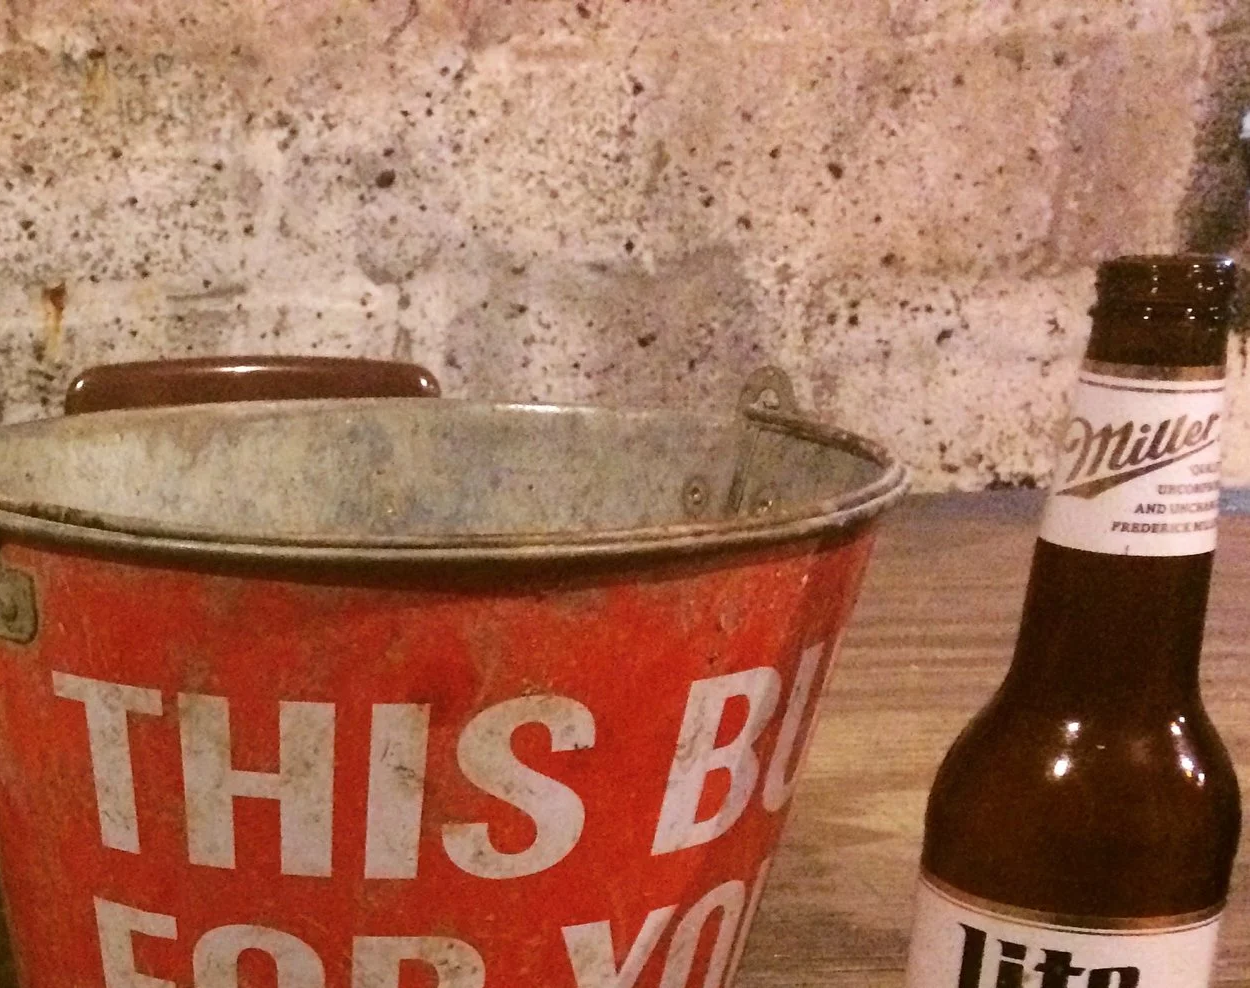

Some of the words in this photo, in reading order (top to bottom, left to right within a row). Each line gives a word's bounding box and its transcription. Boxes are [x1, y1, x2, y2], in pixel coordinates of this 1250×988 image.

[1062, 413, 1220, 483] Miller
[1134, 503, 1167, 515] AND
[52, 670, 597, 881] THIS
